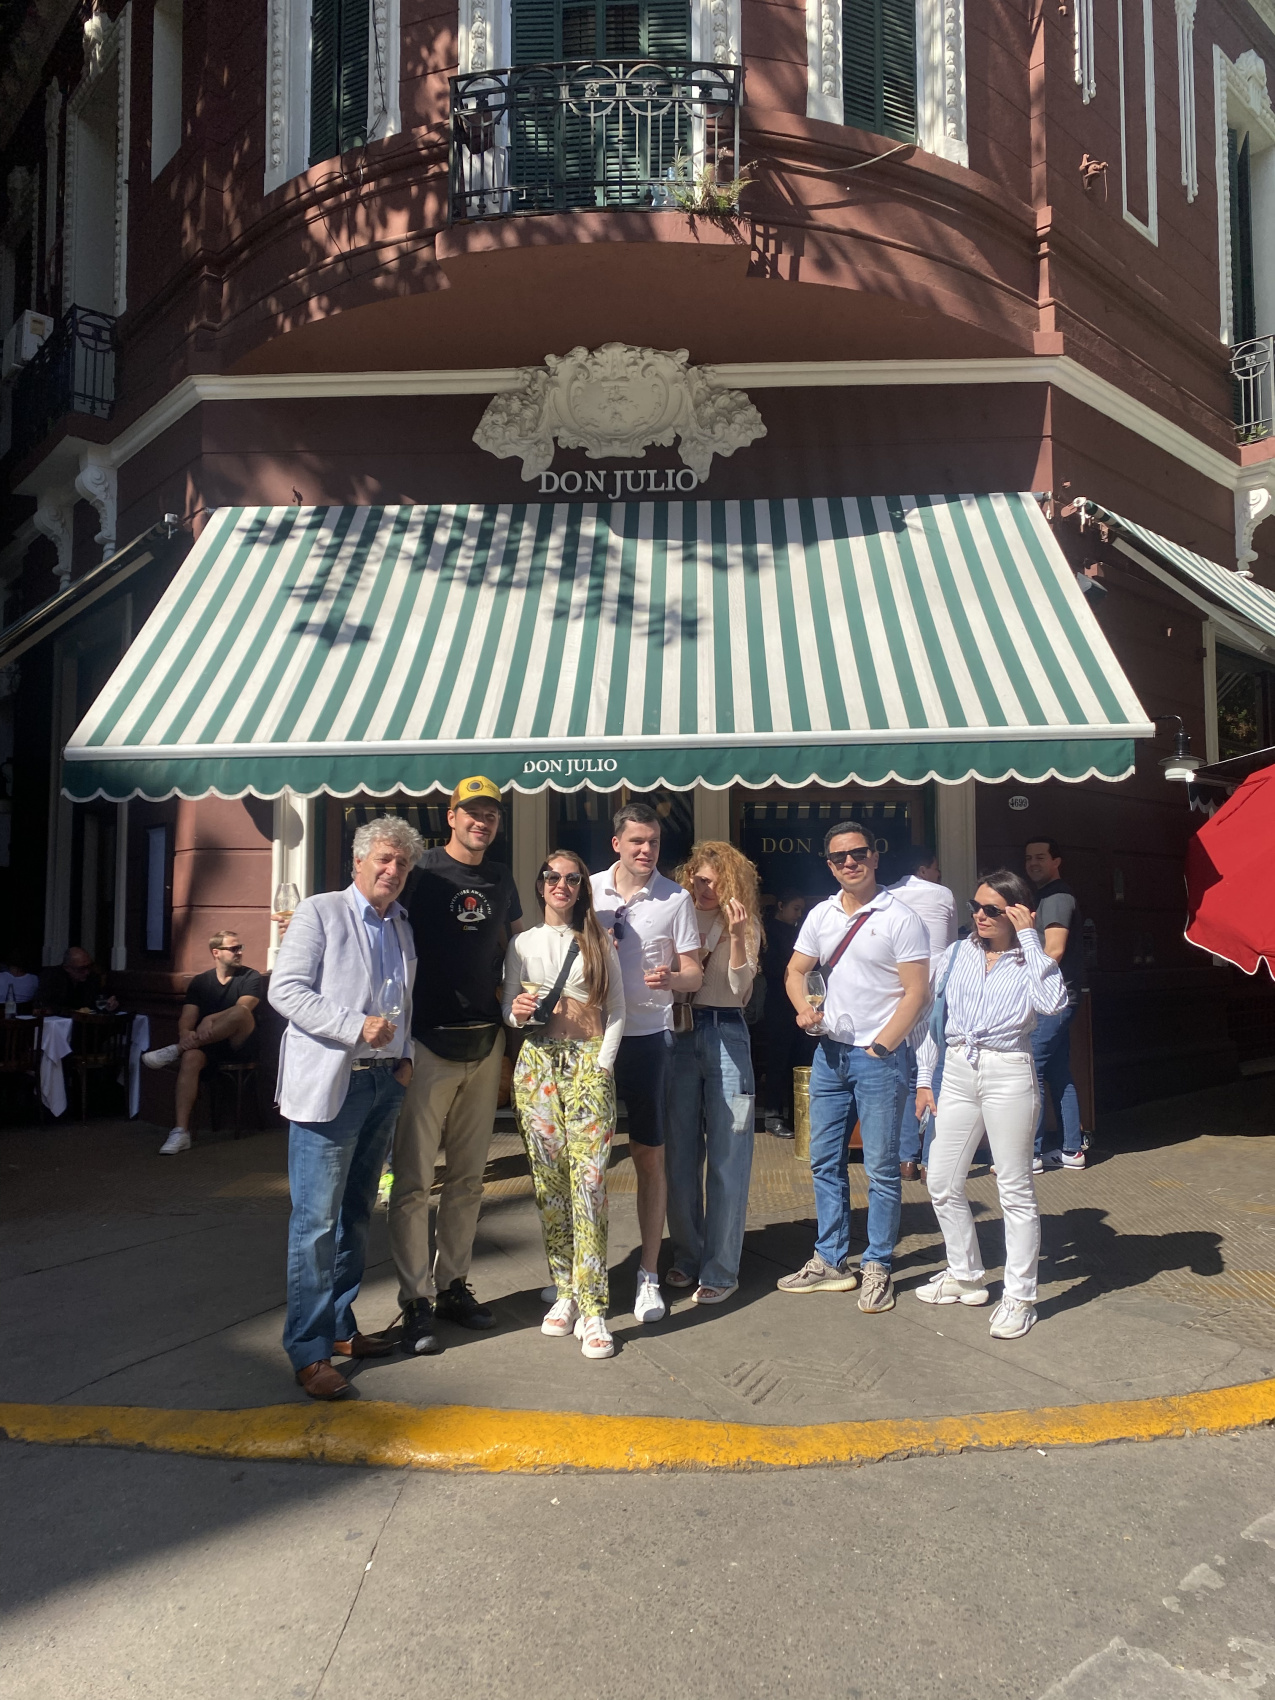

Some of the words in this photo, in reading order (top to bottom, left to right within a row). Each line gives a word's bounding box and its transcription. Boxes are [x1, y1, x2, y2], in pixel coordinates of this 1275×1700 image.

[538, 470, 606, 493] DON
[608, 469, 698, 499] JULIO
[523, 760, 563, 773] DON
[565, 758, 618, 776] JULIO
[761, 837, 812, 853] DON
[450, 889, 470, 912] ADVENTURE
[471, 889, 487, 903] AWAITS
